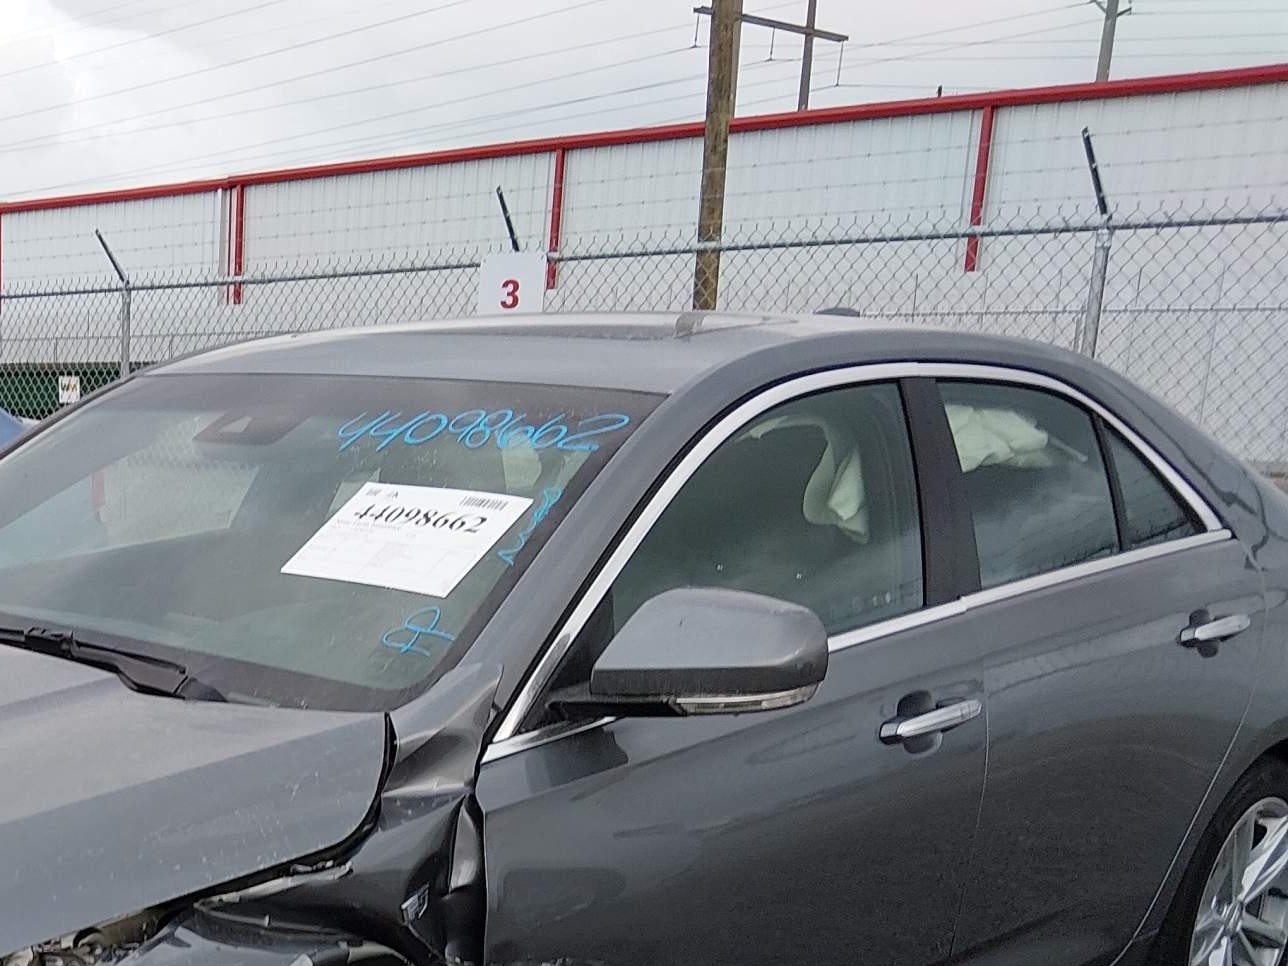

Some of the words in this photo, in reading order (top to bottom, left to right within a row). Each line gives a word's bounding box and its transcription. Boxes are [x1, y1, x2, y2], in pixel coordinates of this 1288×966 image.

[500, 279, 520, 309] 3
[337, 408, 631, 452] 44098662
[354, 503, 488, 534] 44098662
